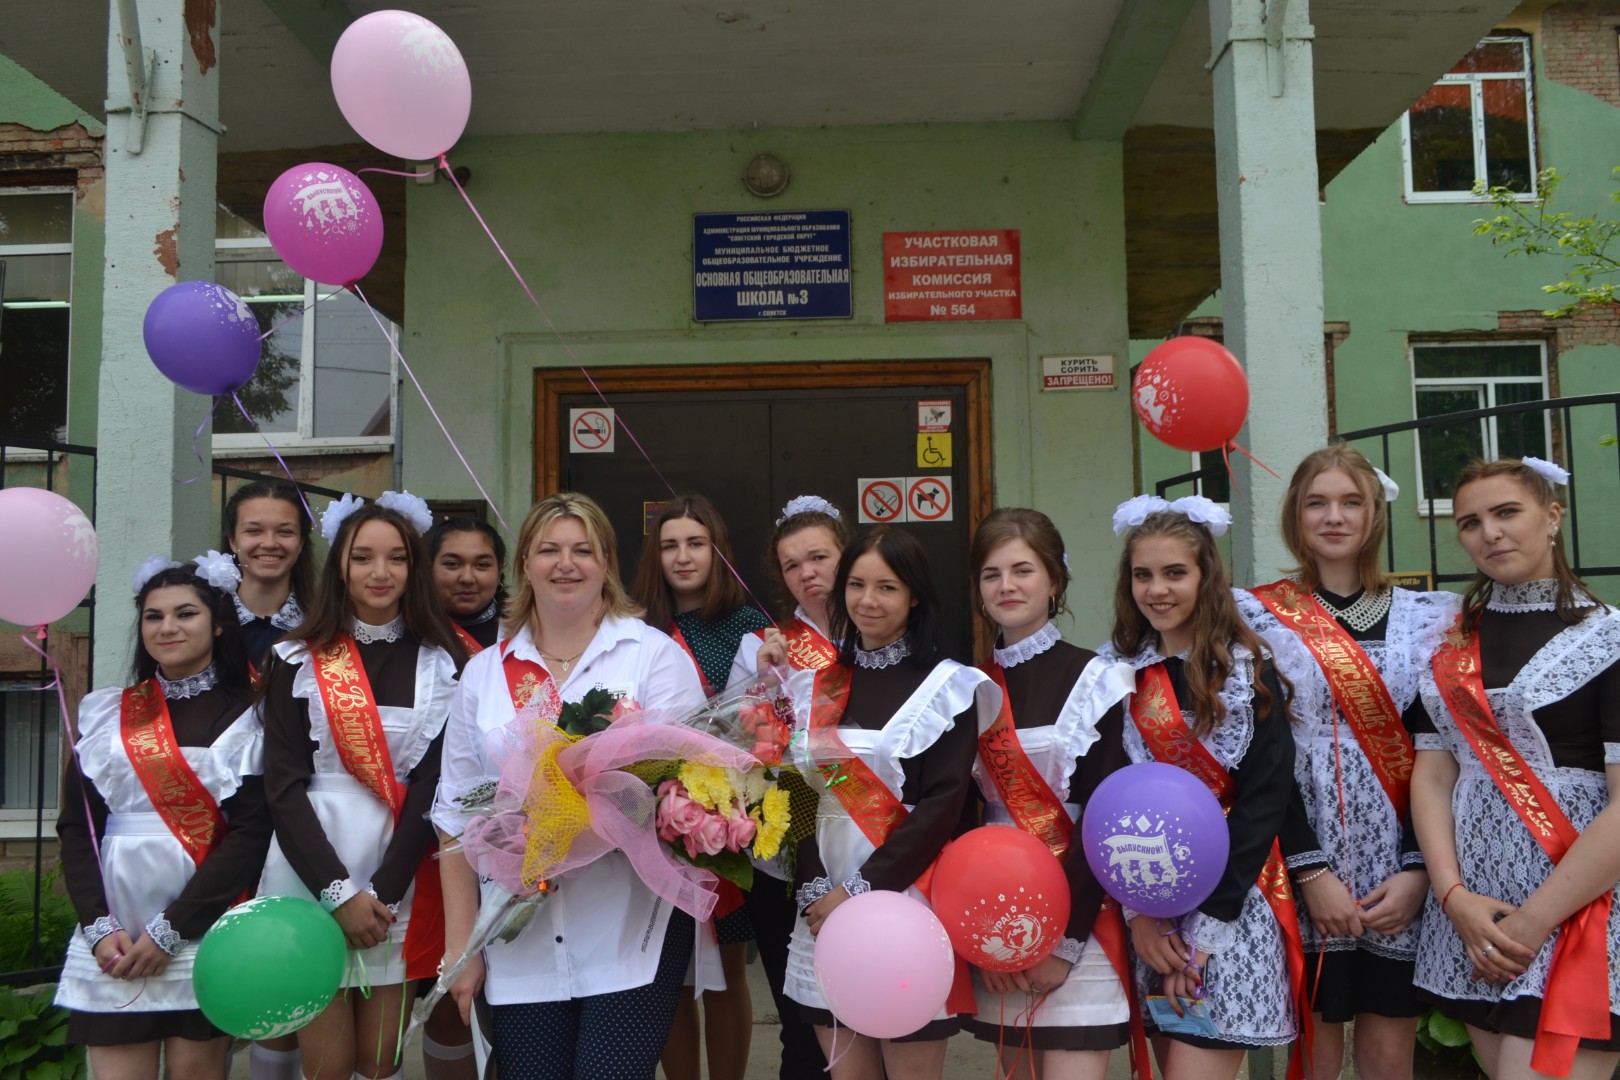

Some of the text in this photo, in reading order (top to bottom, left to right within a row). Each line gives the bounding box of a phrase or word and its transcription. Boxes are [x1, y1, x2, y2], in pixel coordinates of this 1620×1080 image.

[703, 227, 750, 235] АДМИНИСТРАЦИЯ
[750, 226, 801, 234] МУНИЦИПАЛЬНОГО
[763, 233, 795, 241] ГОРОДСКОЙ
[904, 235, 998, 249] УЧАСТКОВАЯ
[714, 245, 830, 256] МУНИЦИПАЛЬНОЕ БЮДЖЕТНОЕ
[702, 254, 842, 265] ОБЩЕОБРАЗОВАТЕЛЬНОЕ УЧРЕЖДЕНИЕ
[890, 253, 1013, 268] ИЗБИРАТЕЛЬНАЯ
[696, 268, 849, 287] ОСНОВНАЯ ОБЩЕОБРАЗОВАТЕЛЬНАЯ
[912, 273, 992, 286] КОМИССИЯ
[737, 290, 784, 306] ШКОЛА
[888, 289, 1017, 300] ИЗБИРАТЕЛЬНОГО УЧАСТКА
[930, 303, 976, 316] № 564
[1061, 358, 1098, 366] КУРИТЬ
[1047, 375, 1112, 386] ЗАПРЕЩЕНО!
[1370, 730, 1413, 781] 2019
[1116, 844, 1164, 855] ВЫПУСКНОЙ!
[991, 913, 1012, 934] УРА!
